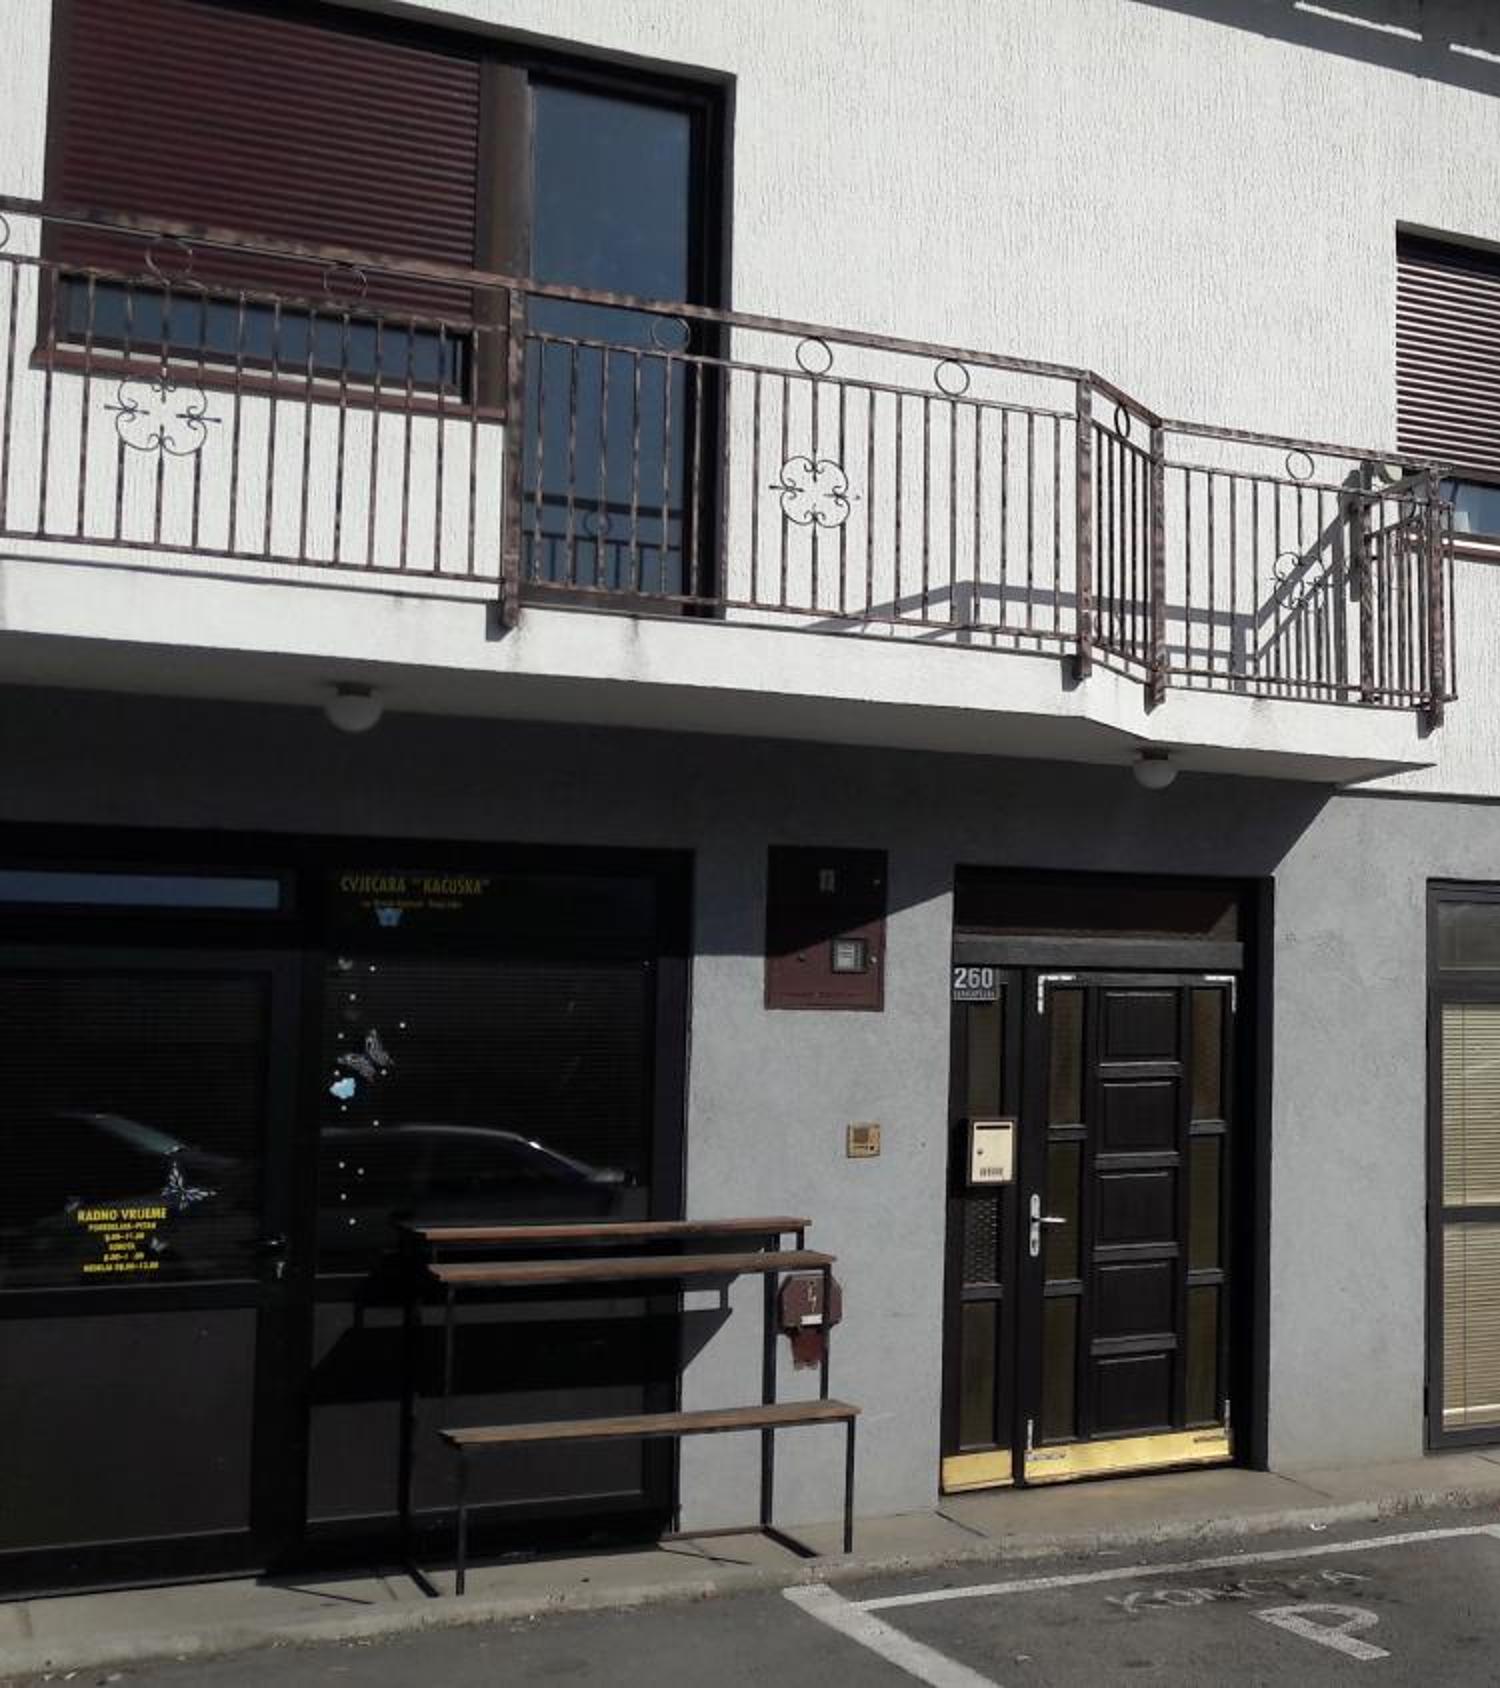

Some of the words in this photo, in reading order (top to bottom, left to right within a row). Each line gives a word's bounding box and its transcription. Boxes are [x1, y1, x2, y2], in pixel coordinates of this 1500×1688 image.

[954, 967, 993, 989] 260
[78, 1208, 117, 1222] RADNO
[1249, 1603, 1392, 1661] P
